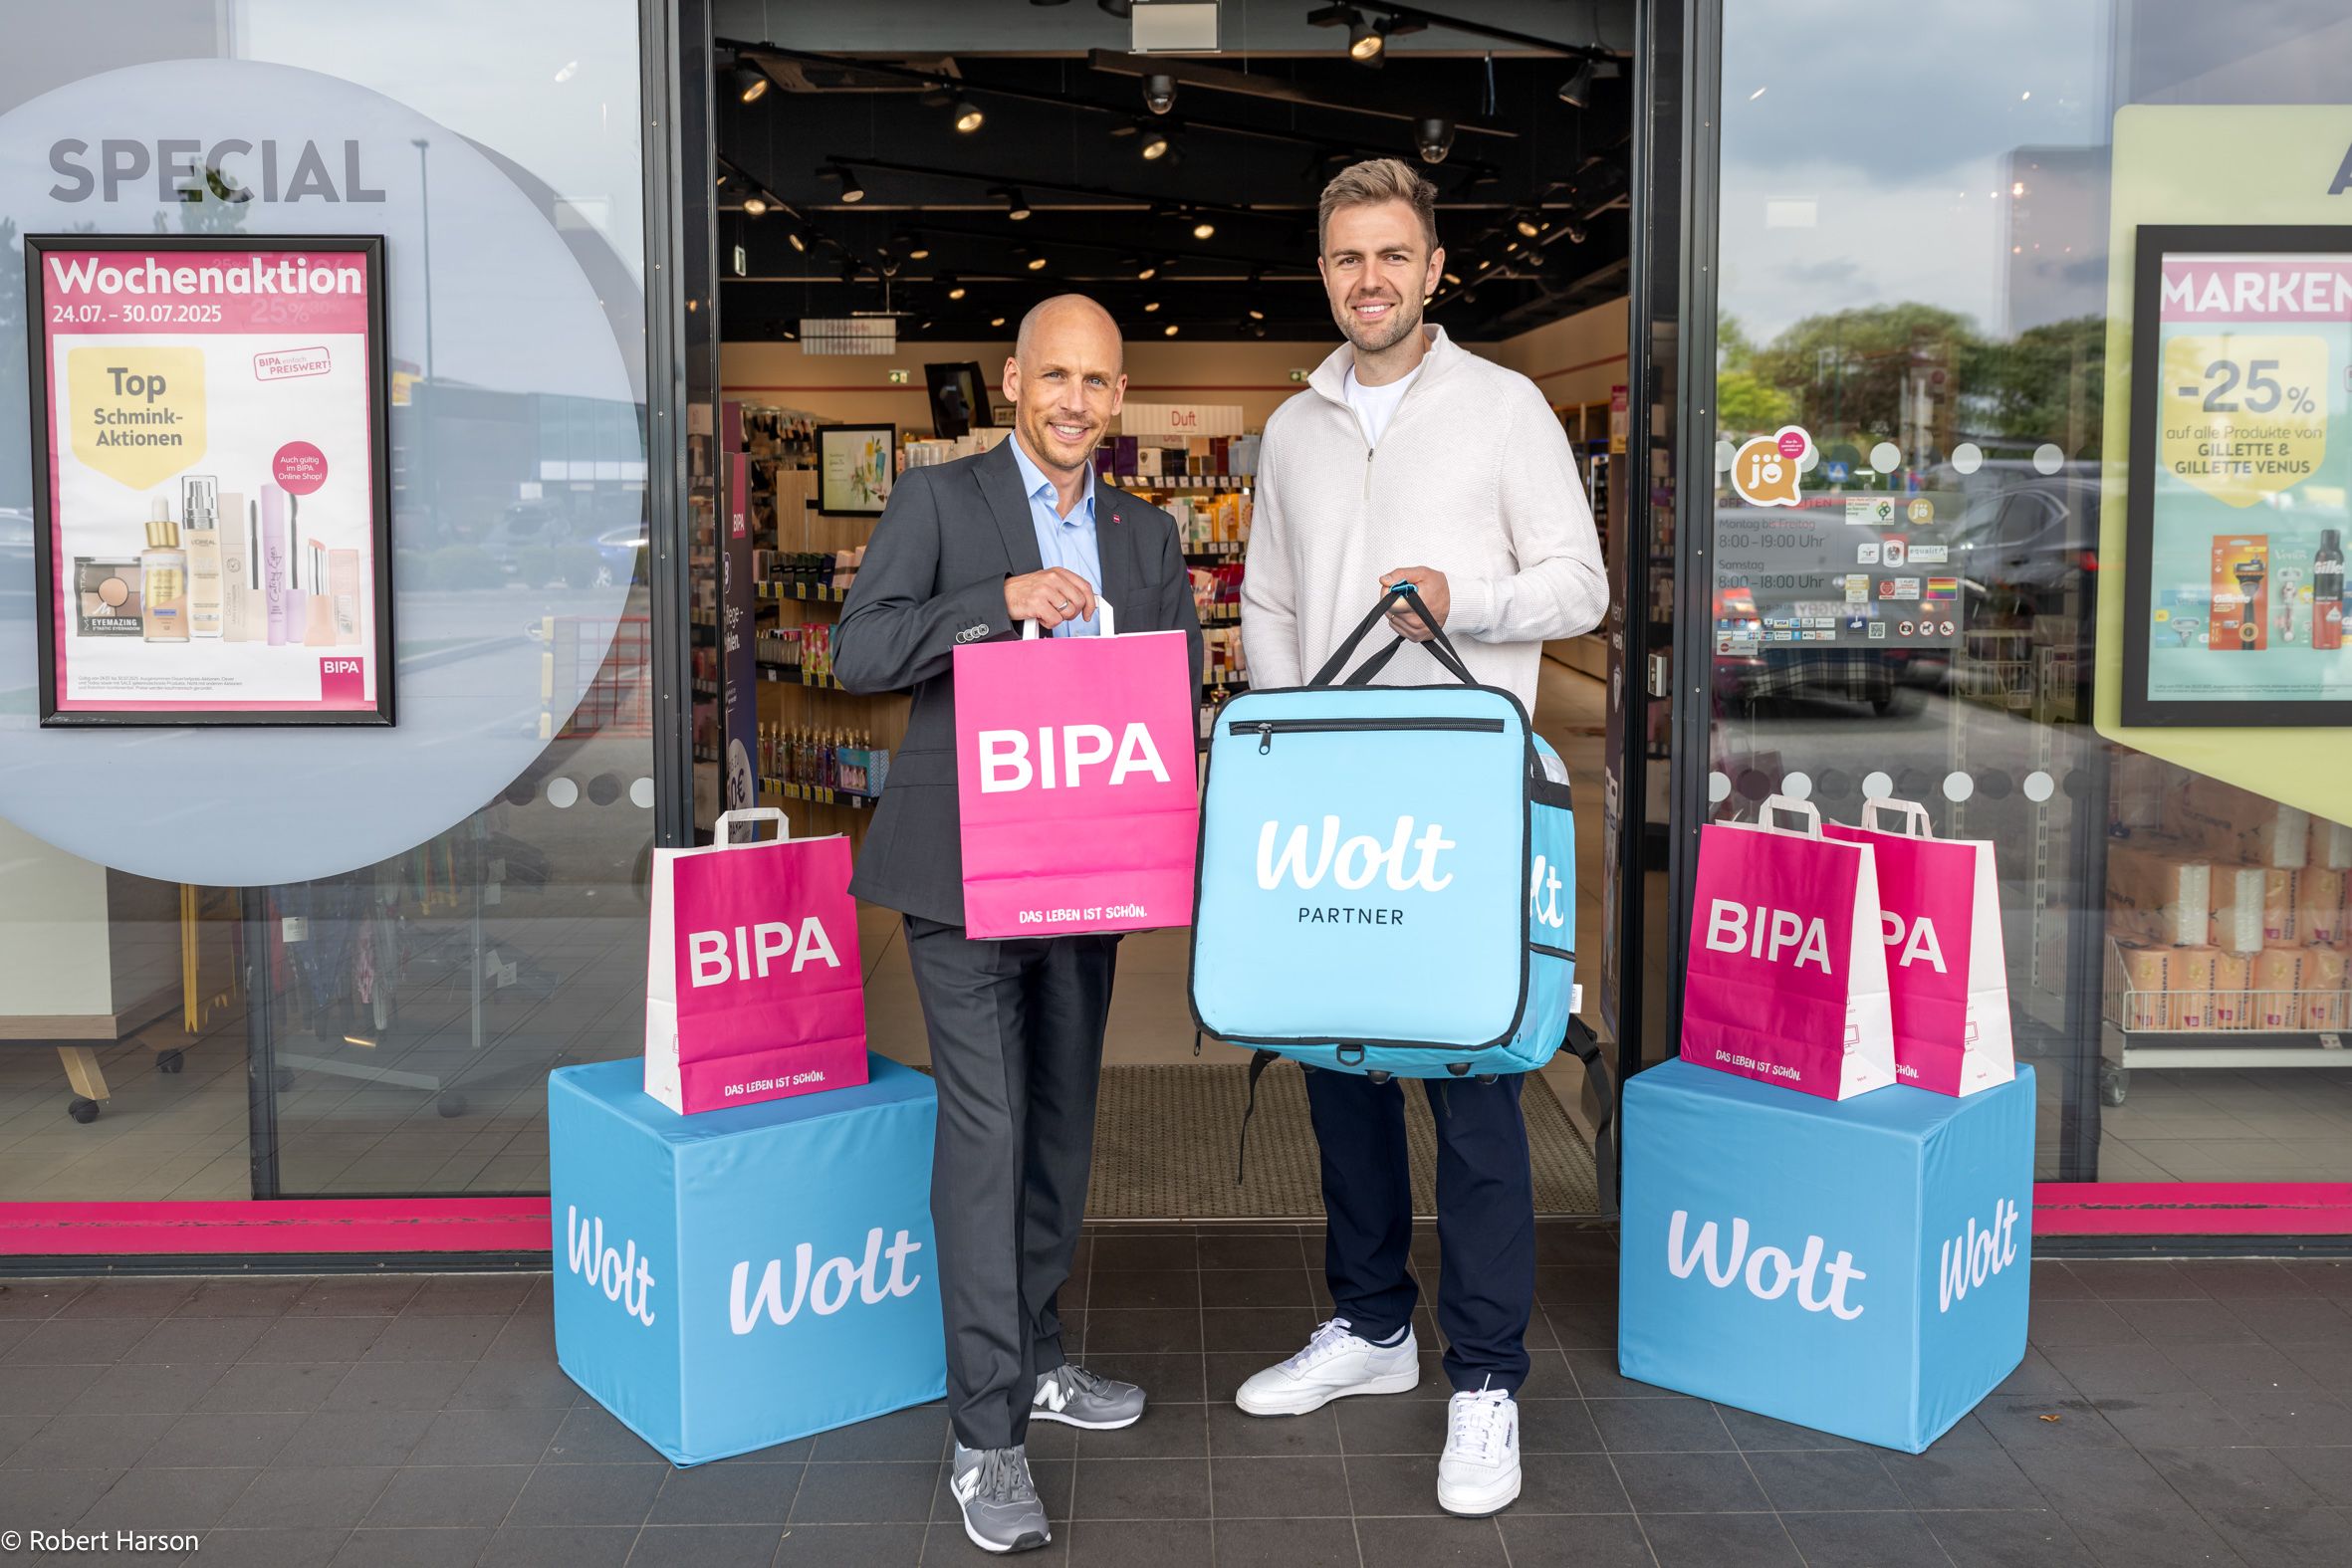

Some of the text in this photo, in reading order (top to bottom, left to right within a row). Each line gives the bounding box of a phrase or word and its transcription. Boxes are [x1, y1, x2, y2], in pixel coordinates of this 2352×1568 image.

[48, 137, 386, 203] SPECIAL
[49, 257, 361, 295] Wochenaktion
[53, 305, 106, 323] 24.07.
[122, 304, 222, 323] 30.07.2025
[259, 357, 281, 367] BIPA
[270, 360, 332, 374] PREISWERT!
[107, 367, 166, 403] Top
[2178, 359, 2315, 414] -25%
[94, 407, 184, 425] Schmink-
[1171, 410, 1197, 427] Duft
[96, 429, 182, 446] Aktionen
[2166, 425, 2323, 440] auf alle Produkte von
[2198, 443, 2290, 457] GILLETTE &
[299, 456, 320, 465] gültig
[2175, 460, 2311, 475] GILLETTE VENUS
[302, 473, 323, 482] Shop!
[733, 514, 745, 532] BIPA
[1719, 520, 1761, 532] Montag
[1779, 519, 1816, 531] Freitag
[1719, 534, 1750, 548] 8:00
[1761, 534, 1795, 548] 19:00
[1799, 534, 1825, 548] Uhr
[1719, 560, 1764, 572] Samstag
[1718, 574, 1749, 588] 8:00
[1761, 574, 1794, 588] 18:00
[1798, 574, 1824, 588] Uhr
[324, 661, 359, 673] BIPA
[978, 722, 1171, 793] BIPA
[1256, 814, 1456, 892] Wolt
[1529, 854, 1564, 929] lt
[1019, 903, 1147, 924] DAS LEBEN IST SCHÖN.
[1298, 907, 1404, 925] PARTNER
[1705, 898, 1832, 975] BIPA
[1880, 910, 1948, 974] PA
[688, 916, 841, 989] BIPA
[1716, 1049, 1801, 1081] DAS LEBEN IST SCHÖN.
[724, 1070, 825, 1097] DAS LEBEN IST SCHÖN.
[1668, 1210, 1867, 1320] Wolt
[1940, 1198, 2018, 1313] Wolt
[568, 1205, 655, 1326] Wolt
[729, 1227, 921, 1335] Wolt
